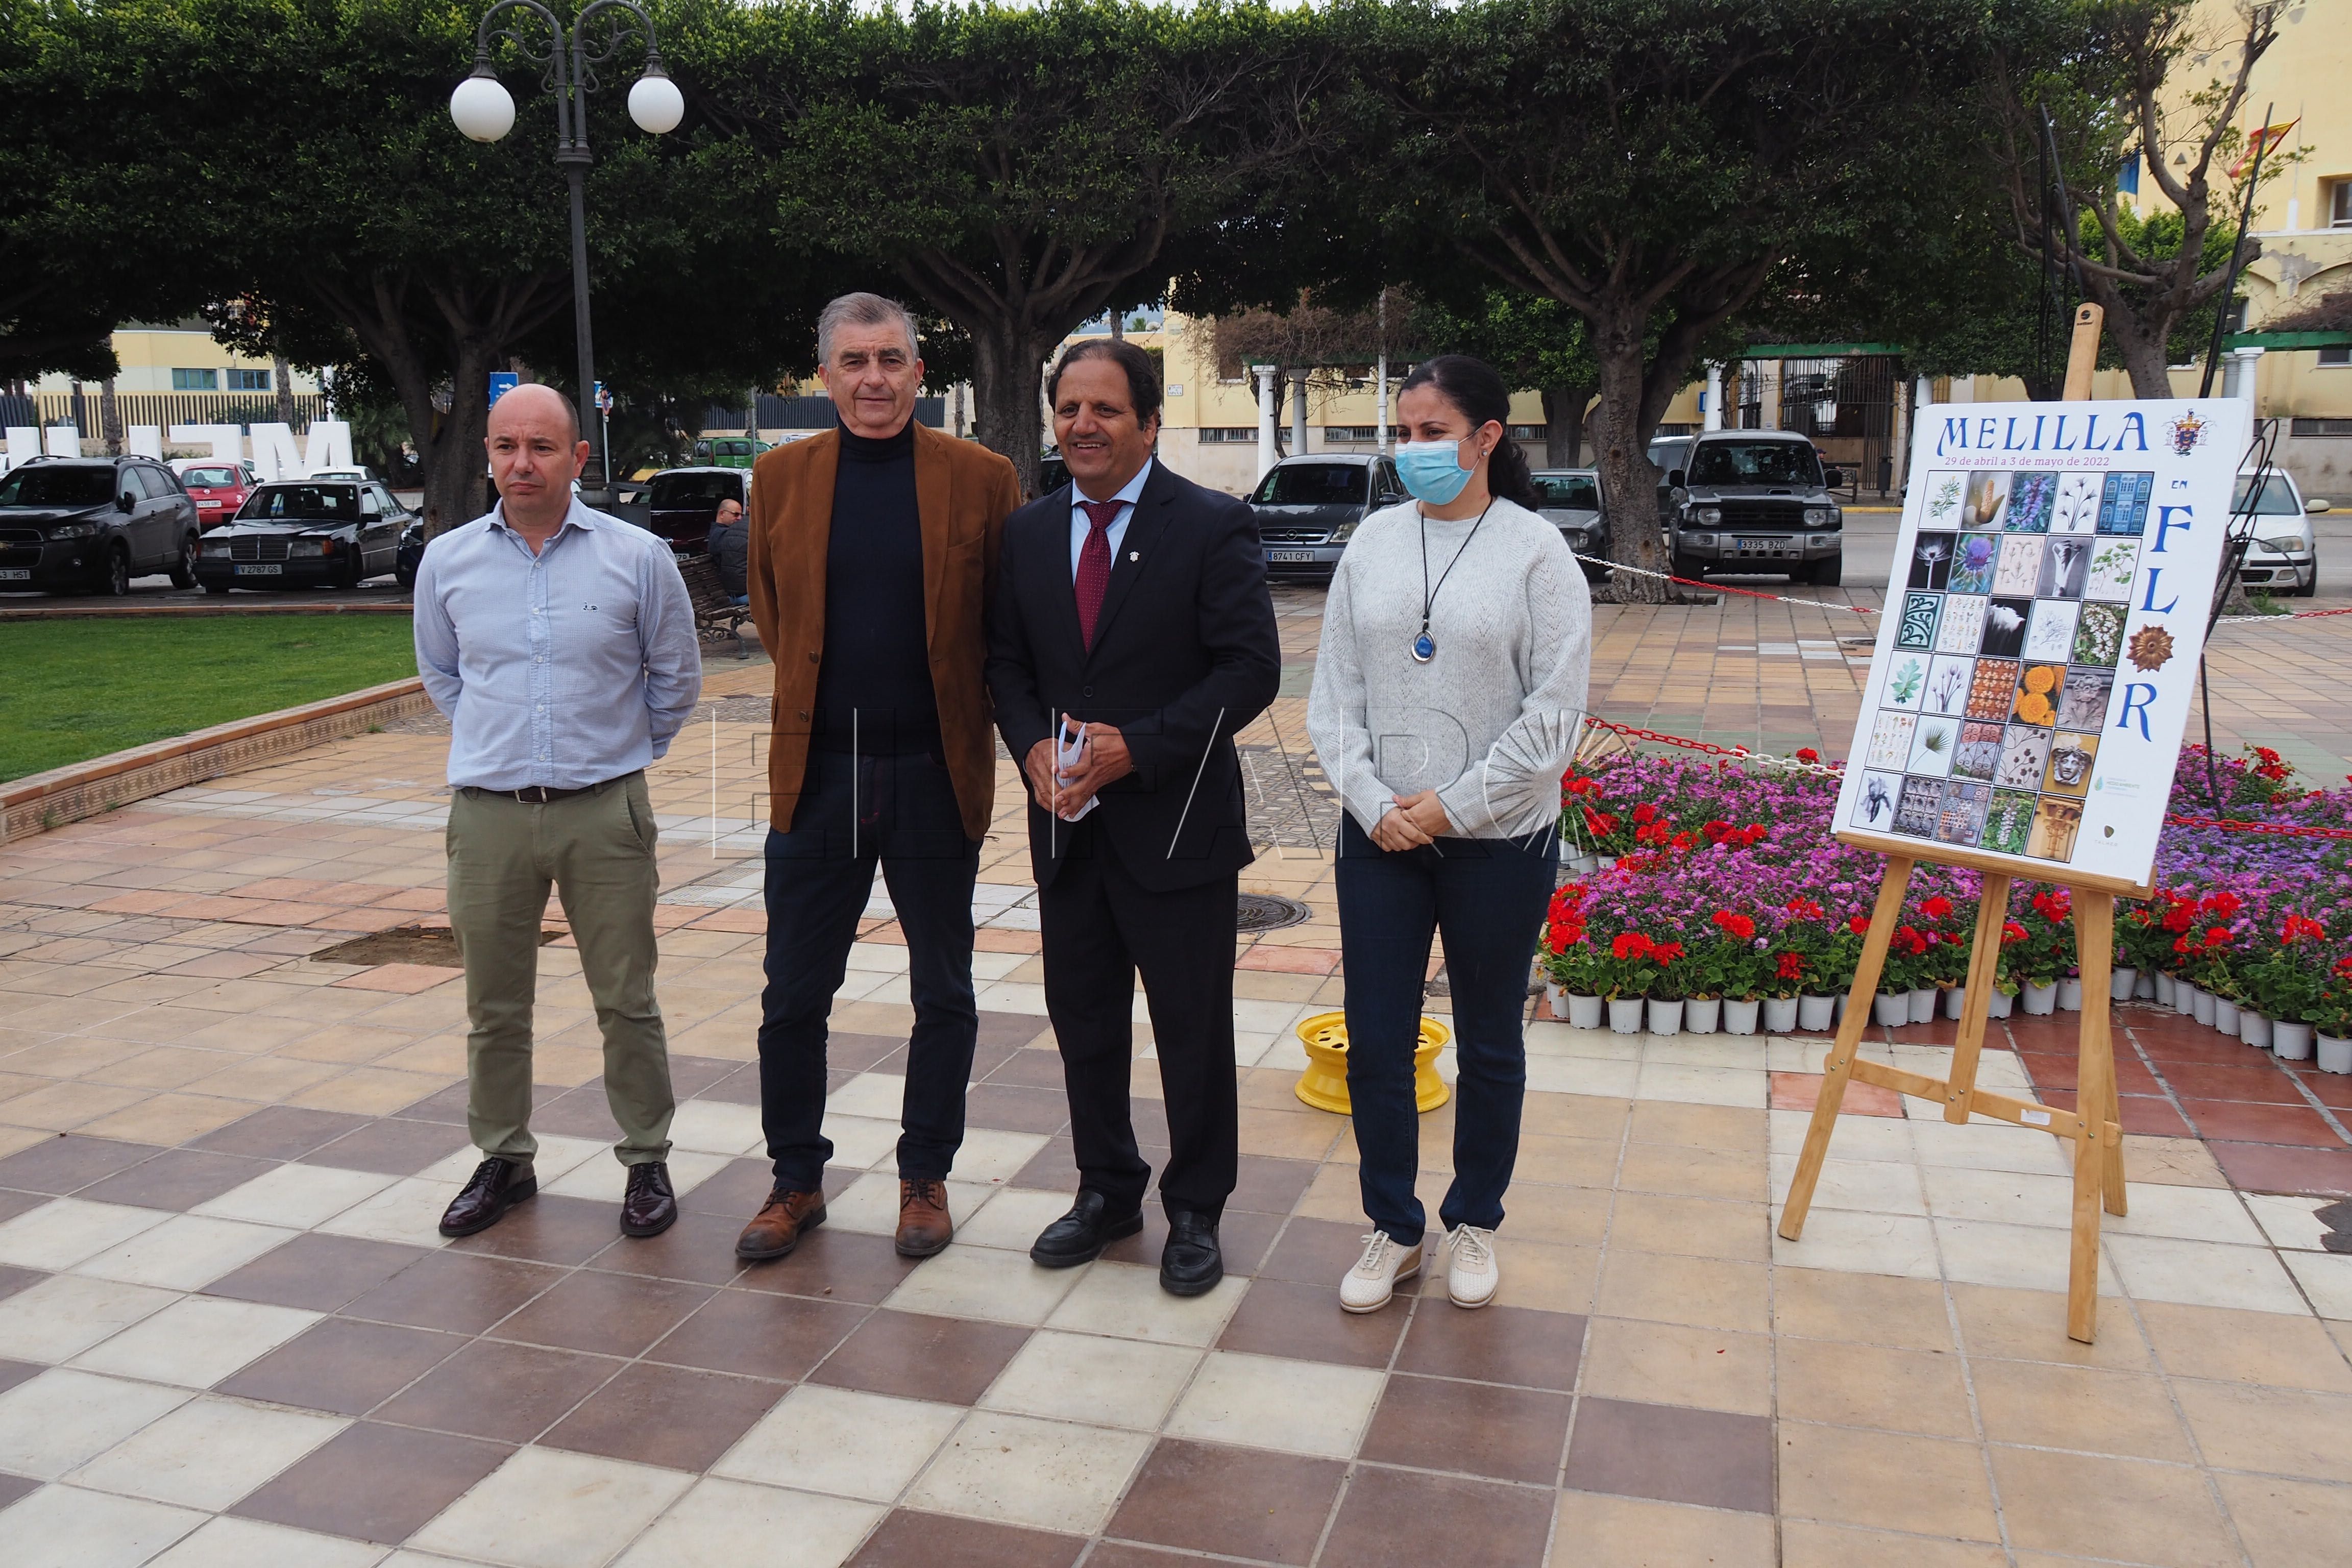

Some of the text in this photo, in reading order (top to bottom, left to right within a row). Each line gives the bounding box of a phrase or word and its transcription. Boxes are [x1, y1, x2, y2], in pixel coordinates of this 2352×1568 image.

[1937, 412, 2149, 456] MELILLA
[1945, 457, 1956, 465] 29
[1959, 457, 1971, 465] de
[1974, 457, 1998, 465] abril
[2010, 457, 2016, 465] 3
[2019, 457, 2031, 465] de
[2034, 459, 2063, 468] mayo
[2067, 457, 2080, 466] de
[2083, 457, 2110, 466] 2022
